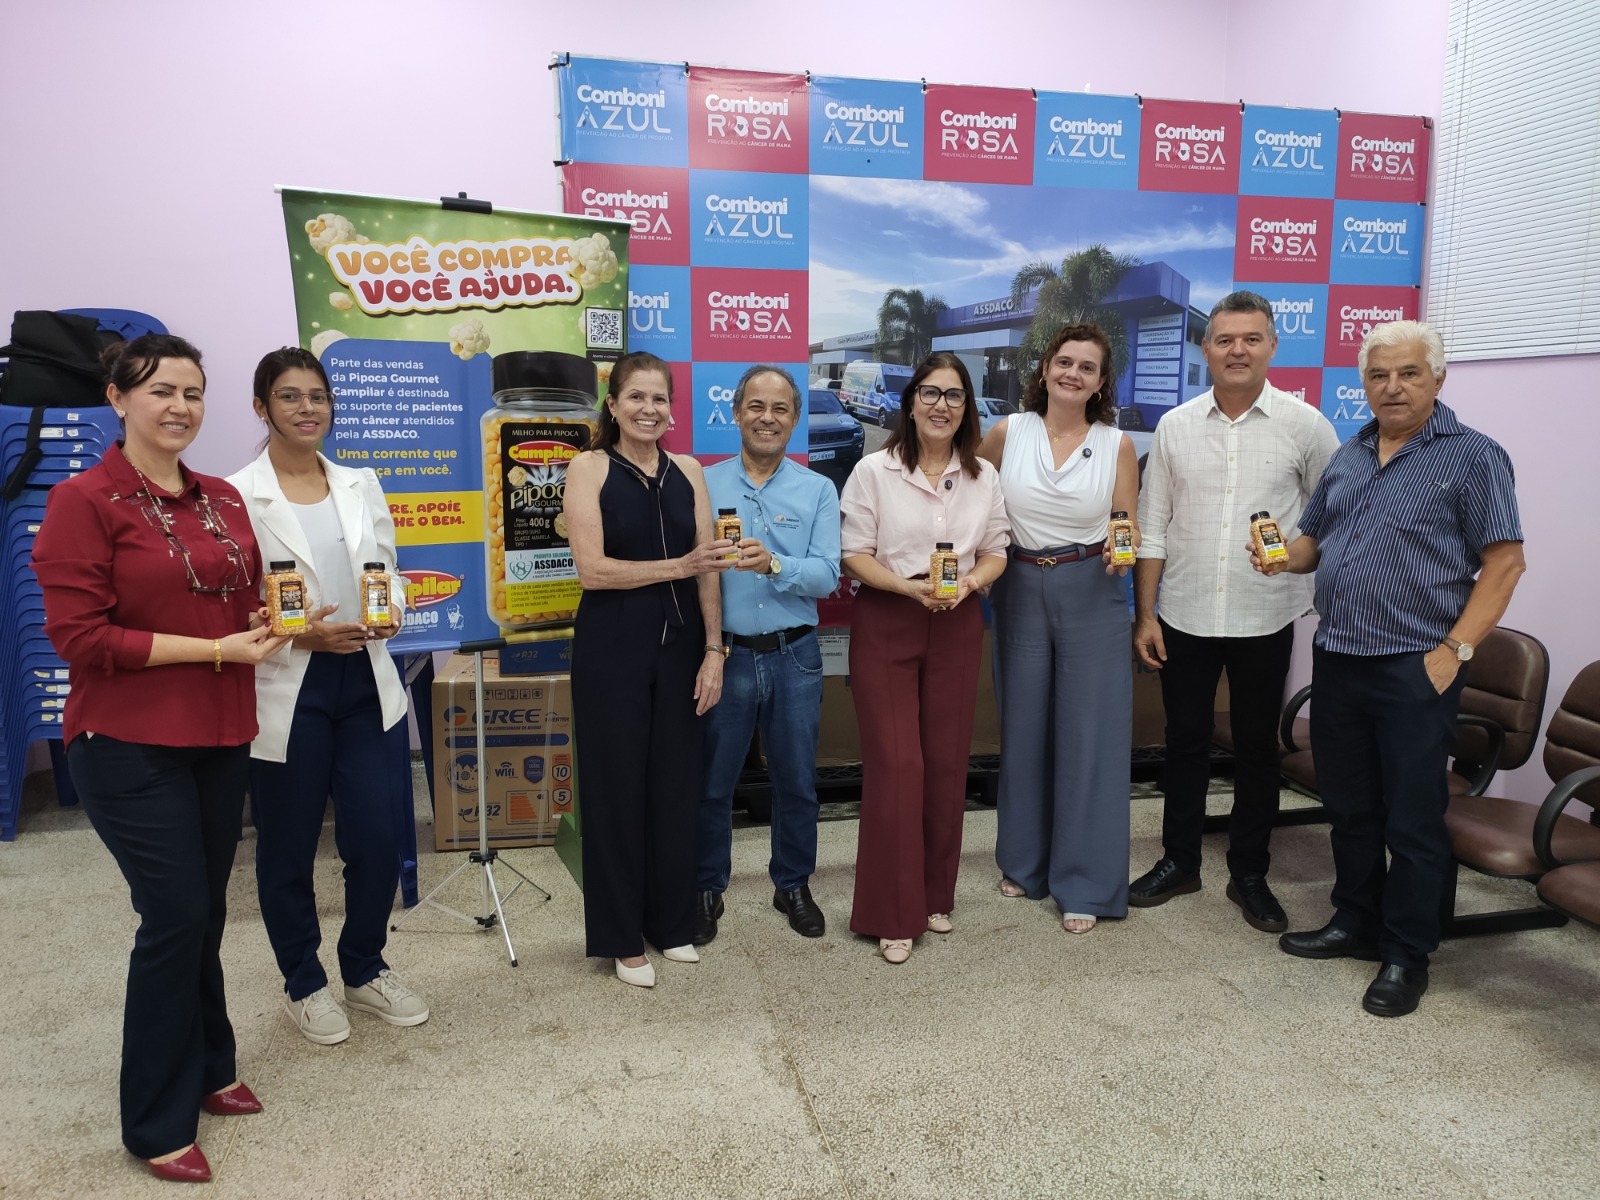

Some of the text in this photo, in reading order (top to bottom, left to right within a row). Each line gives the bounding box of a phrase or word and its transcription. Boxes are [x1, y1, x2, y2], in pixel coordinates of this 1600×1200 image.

[577, 84, 665, 108] Comboni
[705, 94, 788, 115] Comboni
[576, 105, 671, 133] AZUL
[825, 102, 904, 123] Comboni
[941, 110, 1017, 129] Comboni
[823, 121, 909, 147] AZUL
[1050, 116, 1122, 136] Comboni
[1155, 123, 1225, 142] Comboni
[1047, 134, 1125, 159] AZUL
[1255, 129, 1321, 148] Comboni
[1351, 135, 1415, 154] Comboni
[1252, 146, 1324, 170] AZUL
[581, 188, 668, 209] Comboni
[706, 195, 788, 215] Comboni
[705, 213, 793, 239] AZUL
[1250, 218, 1317, 234] Comboni
[1344, 217, 1407, 234] Comboni
[1341, 233, 1408, 255] AZUL
[336, 244, 573, 276] VOCÊ COMPRA
[359, 269, 573, 304] VOCÊ AJUDA.
[708, 291, 789, 309] Comboni
[974, 299, 1014, 316] ASSDACO
[1340, 306, 1403, 320] Comboni
[331, 358, 424, 371] Parte das vendas
[331, 372, 439, 385] da Pipoca Gourmet
[332, 387, 449, 399] Campilar é destinada
[334, 402, 463, 413] ao suporte de pacientes
[334, 415, 454, 426] com câncer atendidos
[336, 430, 420, 441] pela ASSDACO.
[336, 449, 458, 462] Uma corrente que
[395, 467, 416, 476] em
[419, 464, 452, 476] você.
[416, 499, 461, 514] APOIE
[418, 516, 428, 526] O
[431, 515, 465, 526] BEM.
[529, 517, 544, 527] 400
[534, 558, 573, 570] ASSDACO
[472, 708, 542, 725] GREE
[555, 766, 568, 778] 10
[558, 791, 566, 802] 5
